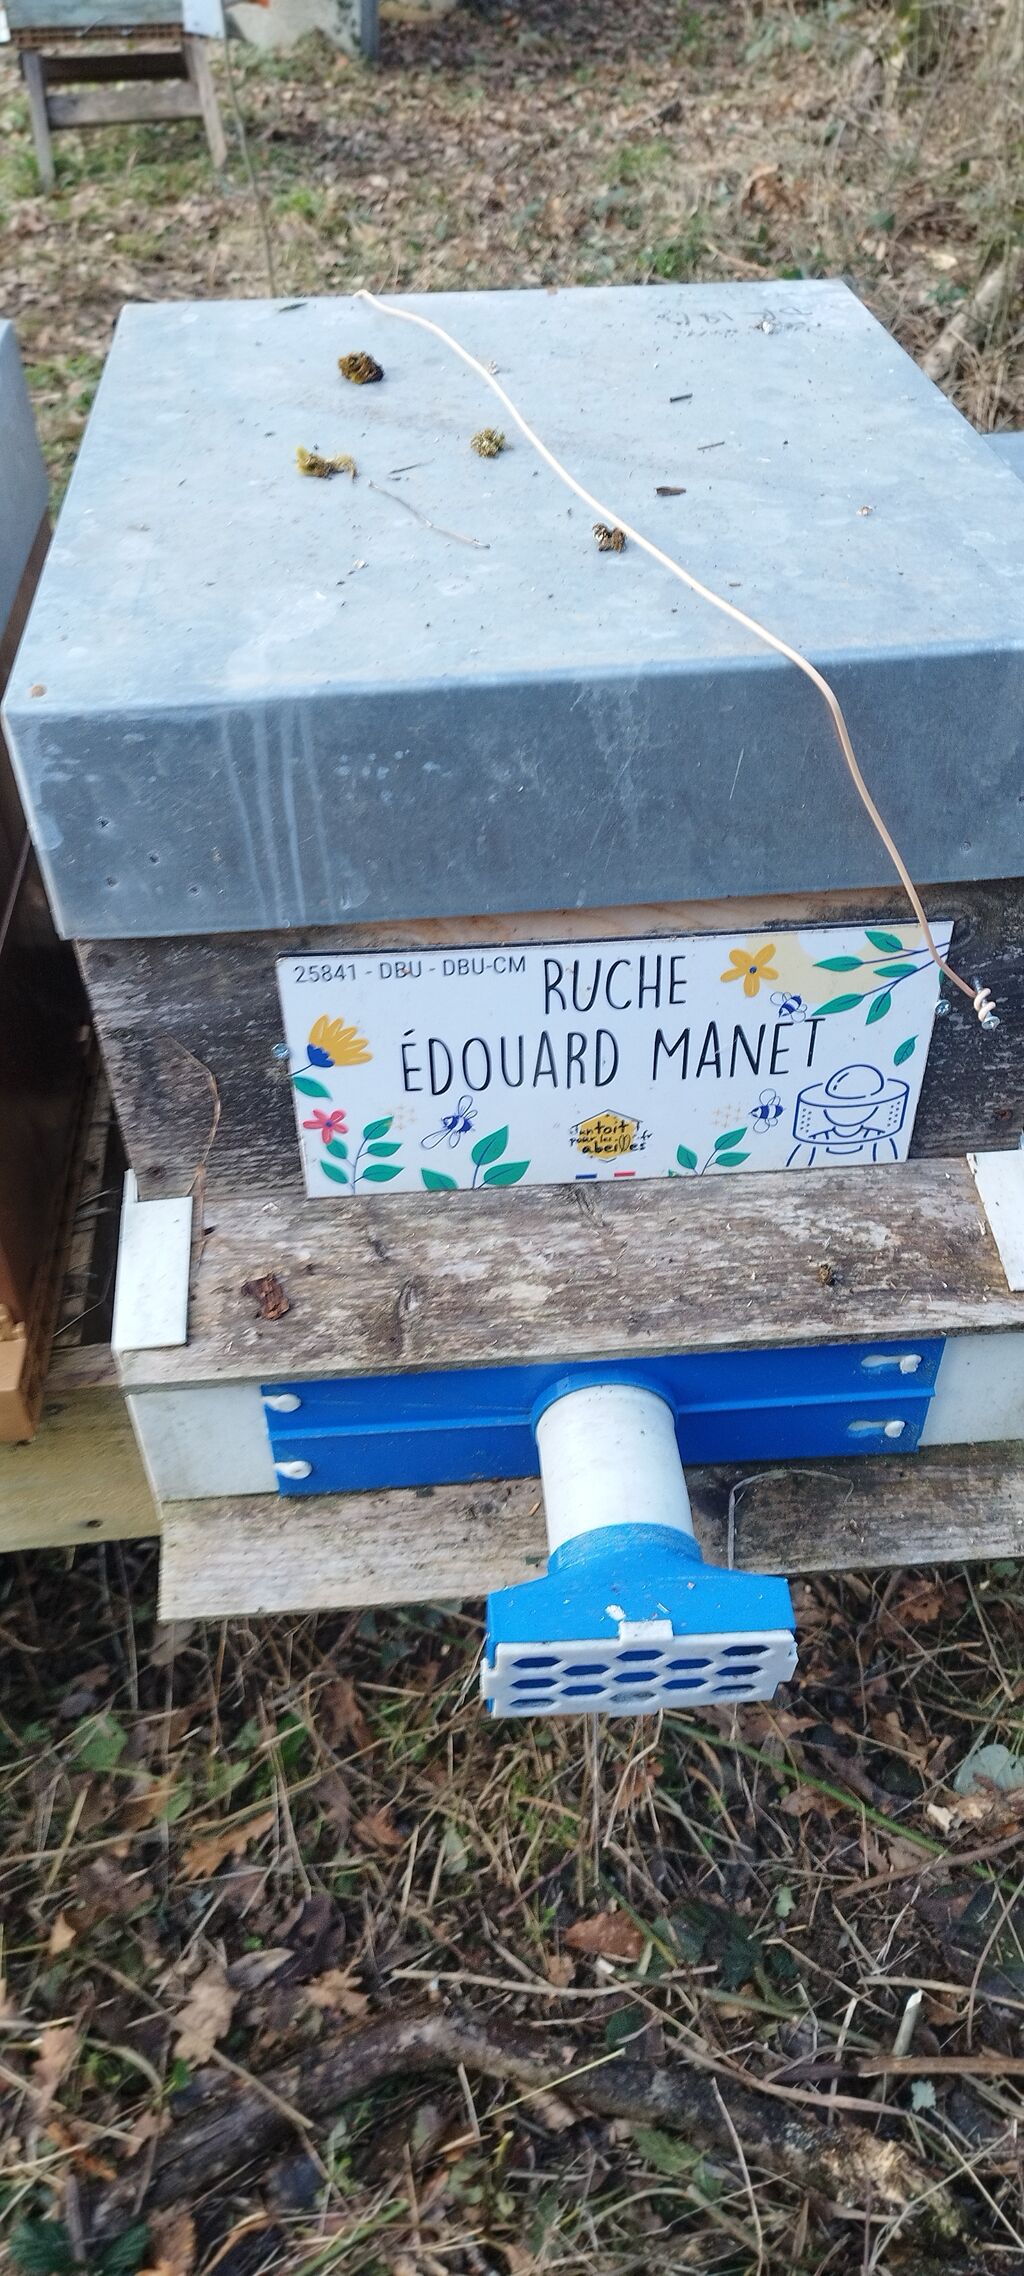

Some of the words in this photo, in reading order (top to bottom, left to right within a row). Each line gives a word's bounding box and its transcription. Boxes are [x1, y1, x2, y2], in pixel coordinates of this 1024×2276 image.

[294, 964, 357, 983] 25841
[379, 960, 422, 980] DBU
[443, 955, 527, 977] DBU-CM
[544, 954, 688, 1015] RUCHE
[401, 1029, 619, 1096] ÉDOUARD
[652, 1017, 827, 1081] MANET
[594, 1119, 630, 1136] toit
[582, 1134, 647, 1154] abeilles
